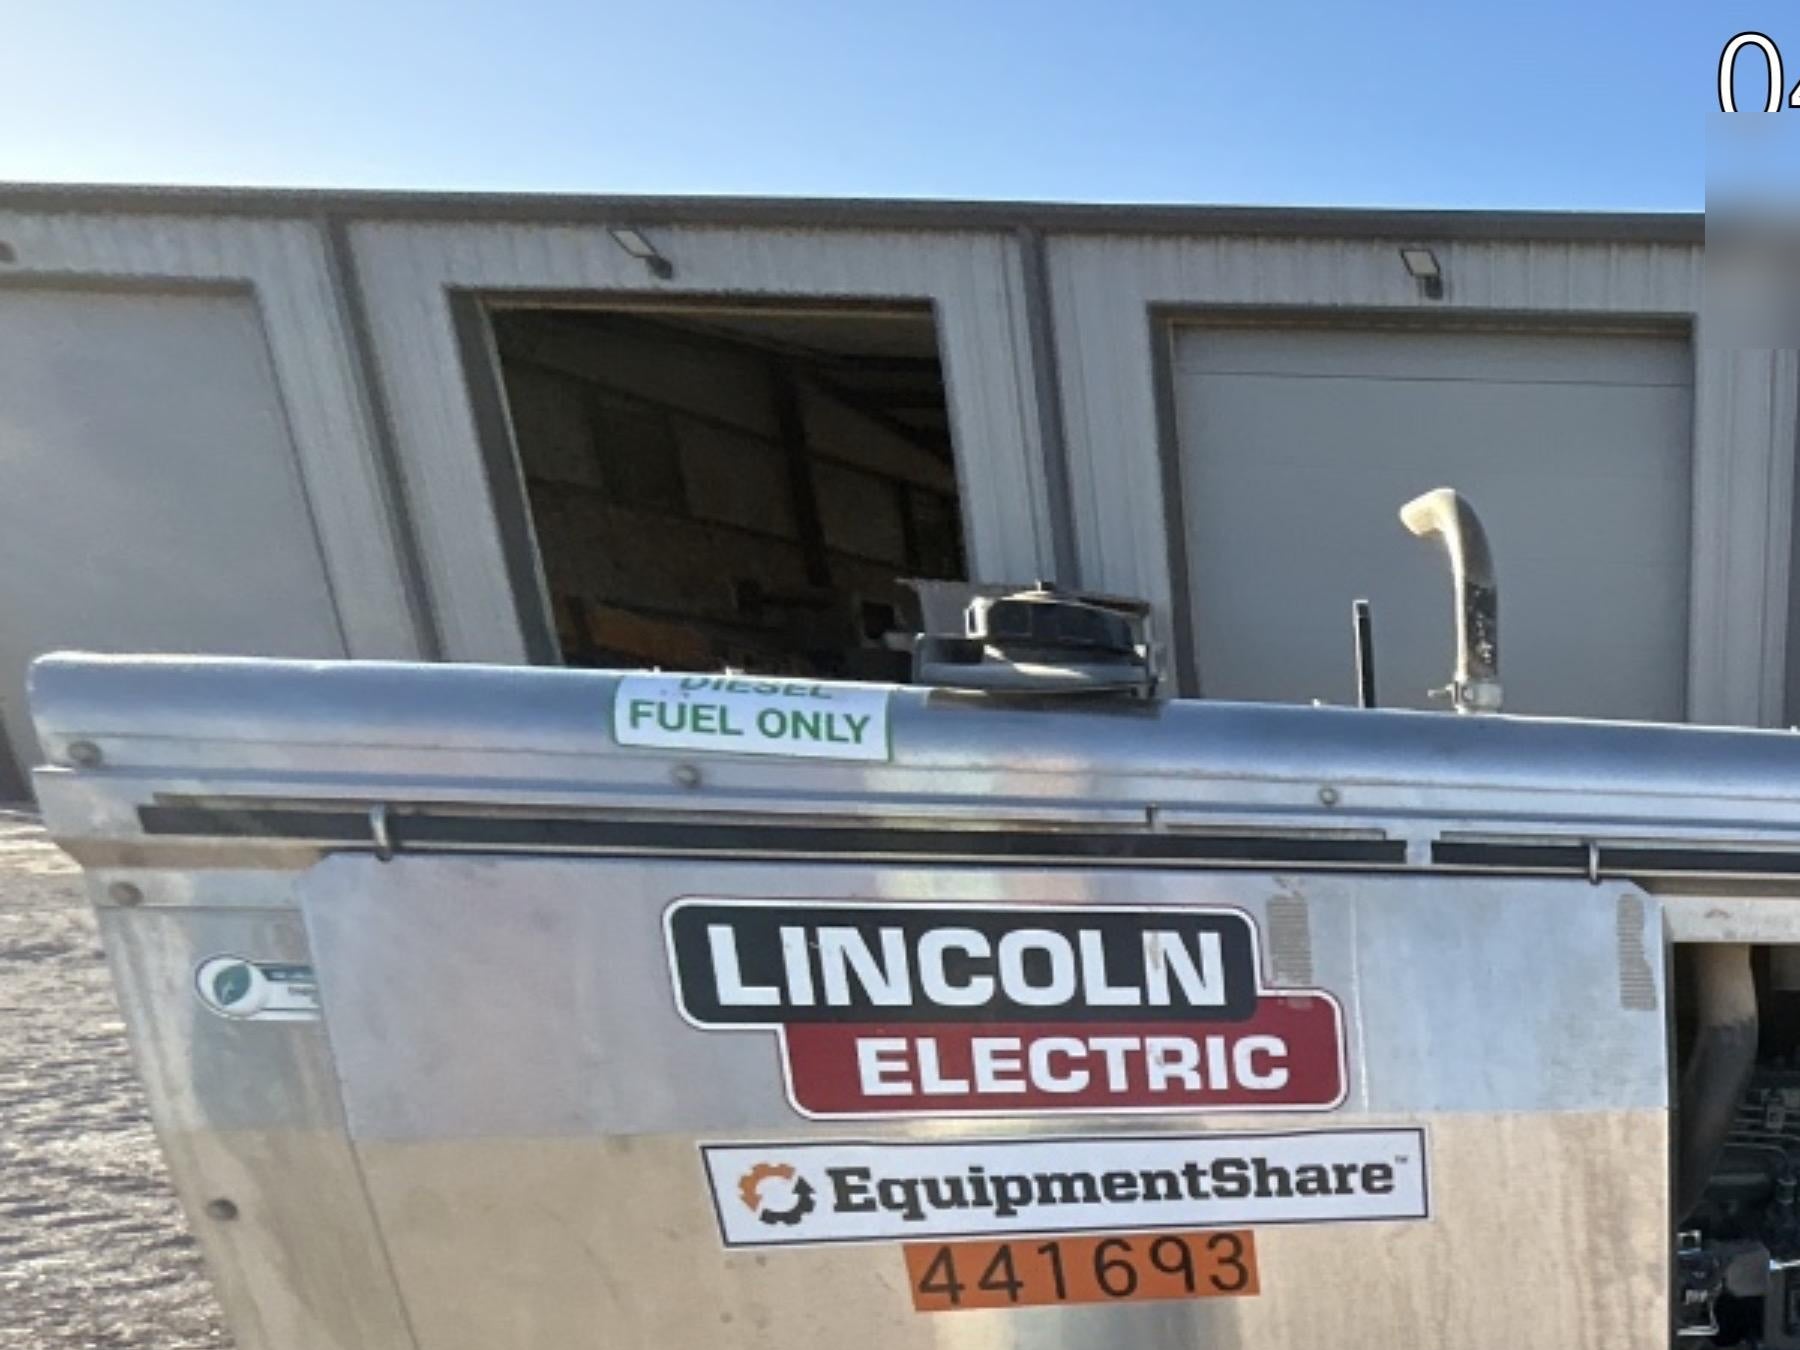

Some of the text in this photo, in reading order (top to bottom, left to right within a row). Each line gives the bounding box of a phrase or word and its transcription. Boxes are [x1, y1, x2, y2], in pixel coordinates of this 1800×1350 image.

[679, 677, 833, 700] DIESEL
[628, 698, 871, 745] FUEL ONLY
[706, 923, 1227, 1006] LINCOLN
[855, 1034, 1289, 1096] ELECTRIC
[918, 1231, 1250, 1305] 441693
